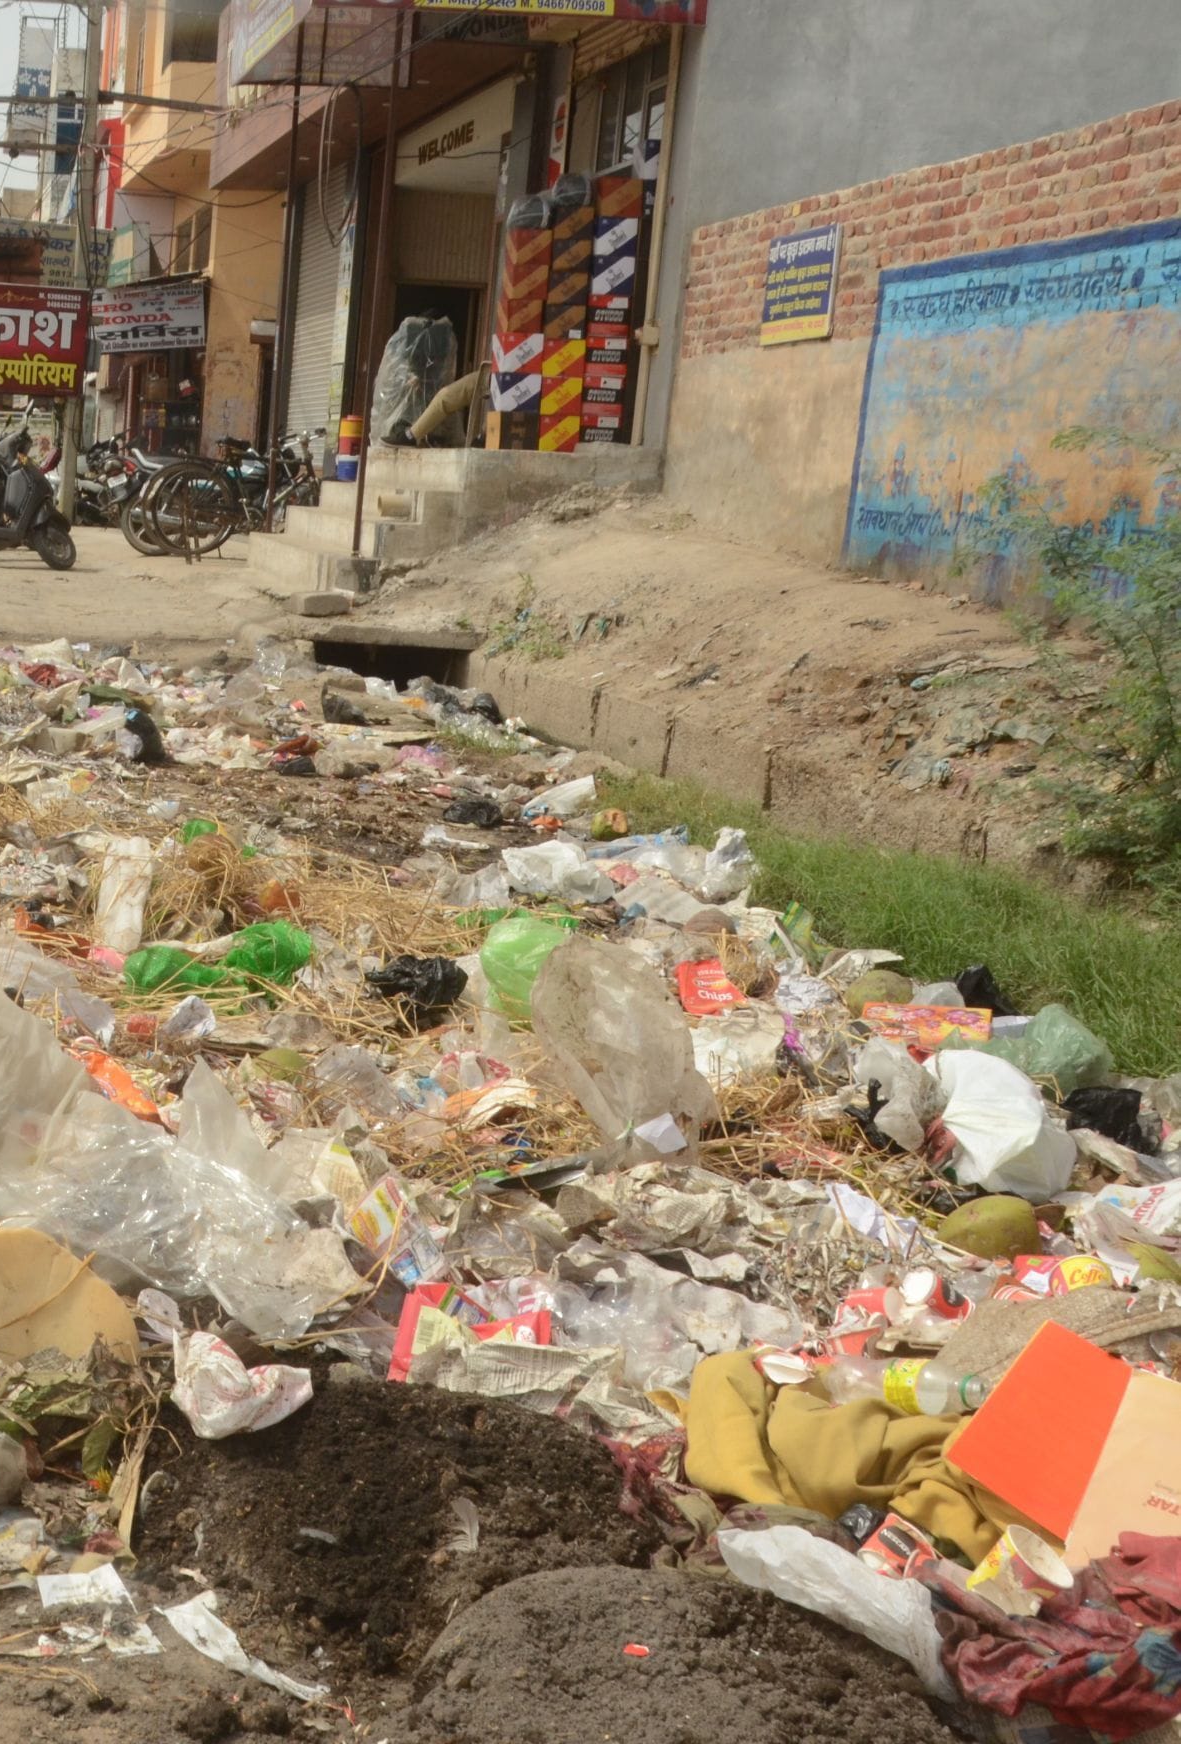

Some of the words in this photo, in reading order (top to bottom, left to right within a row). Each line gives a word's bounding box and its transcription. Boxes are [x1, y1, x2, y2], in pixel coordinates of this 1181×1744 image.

[419, 120, 474, 166] WELCOME
[92, 303, 133, 314] ERO
[96, 323, 202, 341] सर्विस
[697, 990, 733, 1002] Chips
